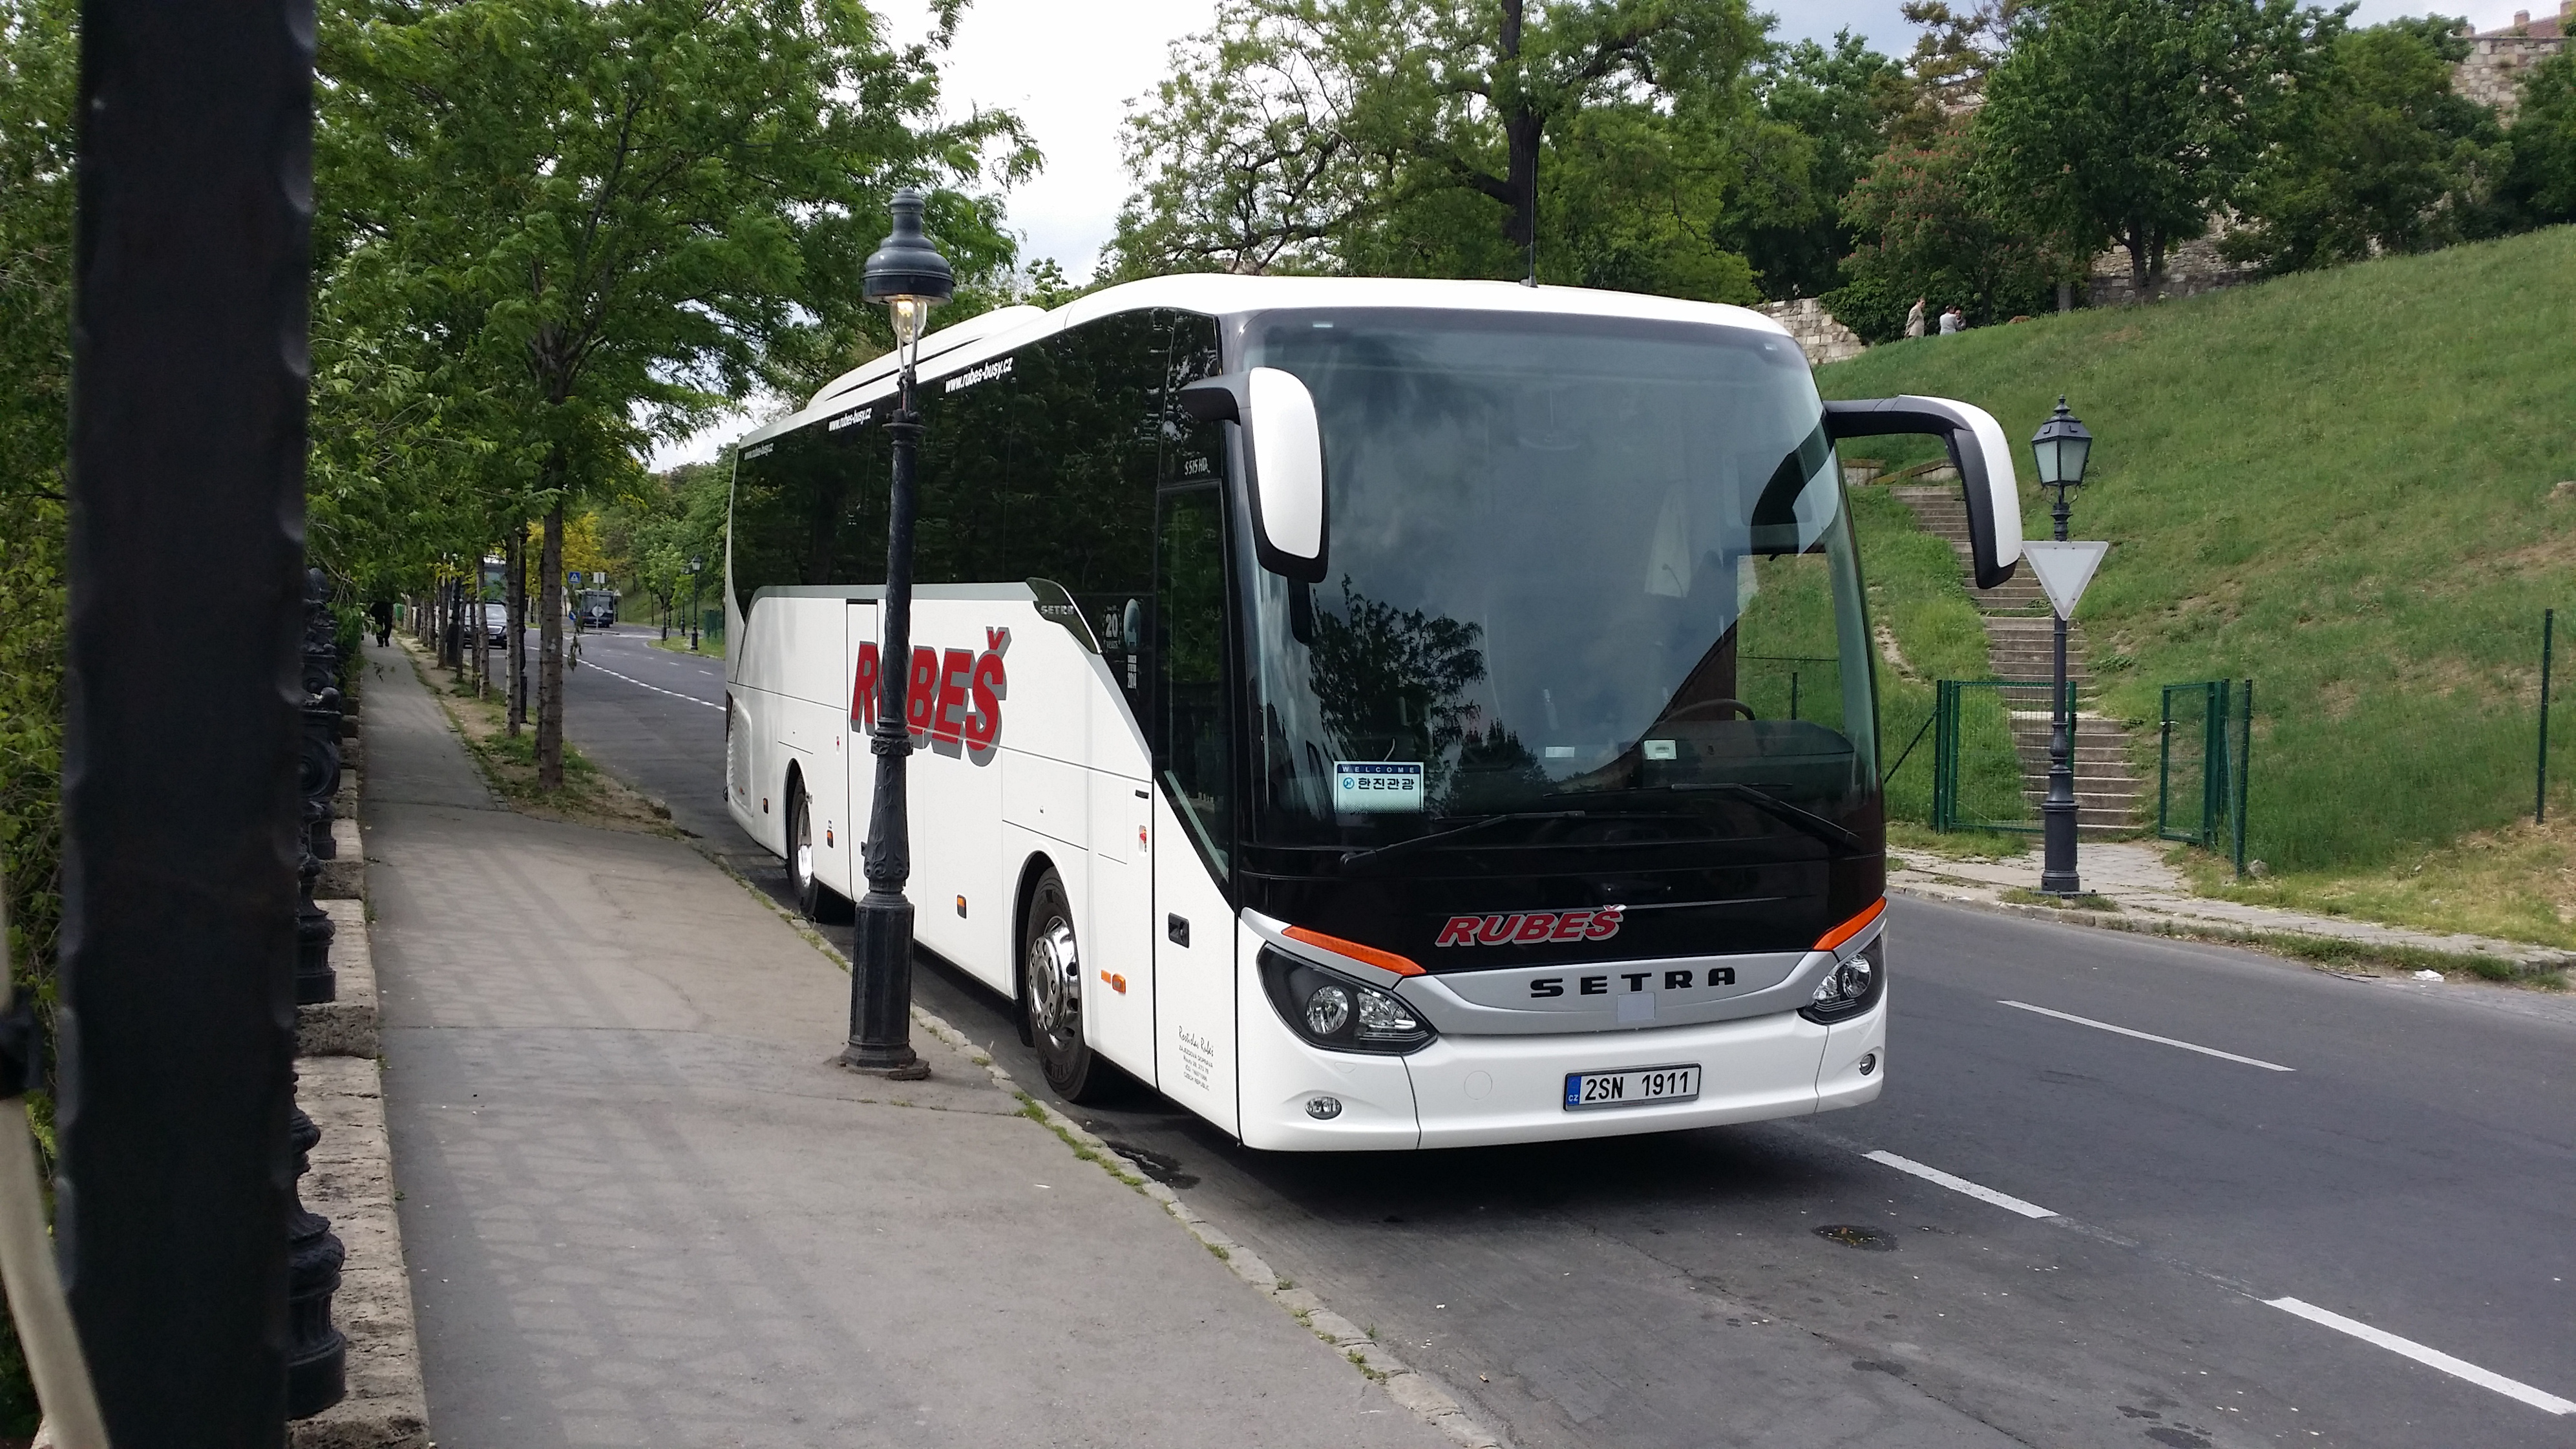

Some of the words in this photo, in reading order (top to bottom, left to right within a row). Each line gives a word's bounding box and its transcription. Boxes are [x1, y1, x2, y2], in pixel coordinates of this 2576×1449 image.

[945, 357, 1013, 394] www.rubes-busy.cz
[829, 407, 872, 432] www.rubes-busy.cz
[1188, 458, 1199, 475] 515
[1040, 605, 1074, 615] SETRA
[1106, 613, 1118, 638] 20
[850, 626, 1012, 767] RBEŠ
[1358, 777, 1415, 790] 한진관광
[1435, 905, 1627, 947] RUBEŠ
[1530, 967, 1737, 999] SETRA
[1568, 1094, 1579, 1102] CZ
[1585, 1076, 1624, 1101] 2SN
[1642, 1071, 1689, 1097] 1911
